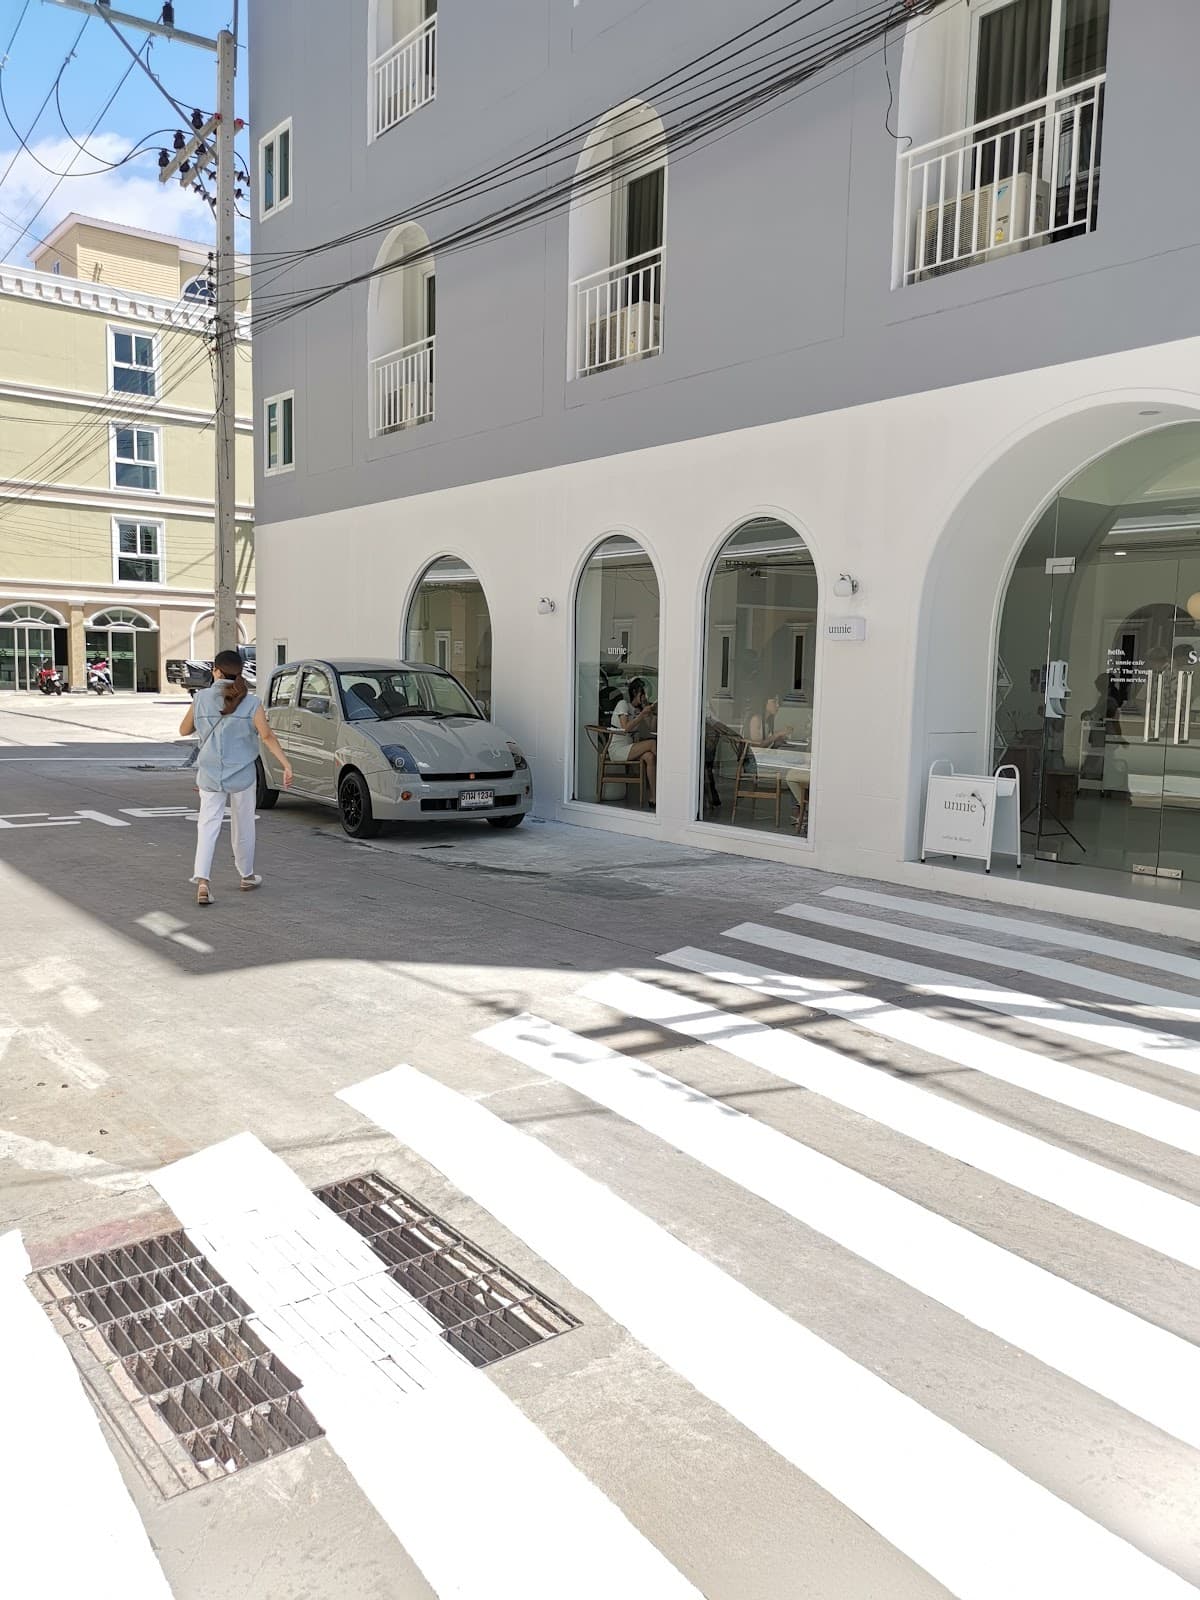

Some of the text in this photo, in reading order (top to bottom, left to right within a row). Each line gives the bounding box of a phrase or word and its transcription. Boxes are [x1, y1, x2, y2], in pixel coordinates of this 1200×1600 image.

[828, 624, 852, 634] unnie
[607, 644, 628, 655] unnie
[478, 791, 493, 800] 1234
[944, 800, 977, 813] unnie
